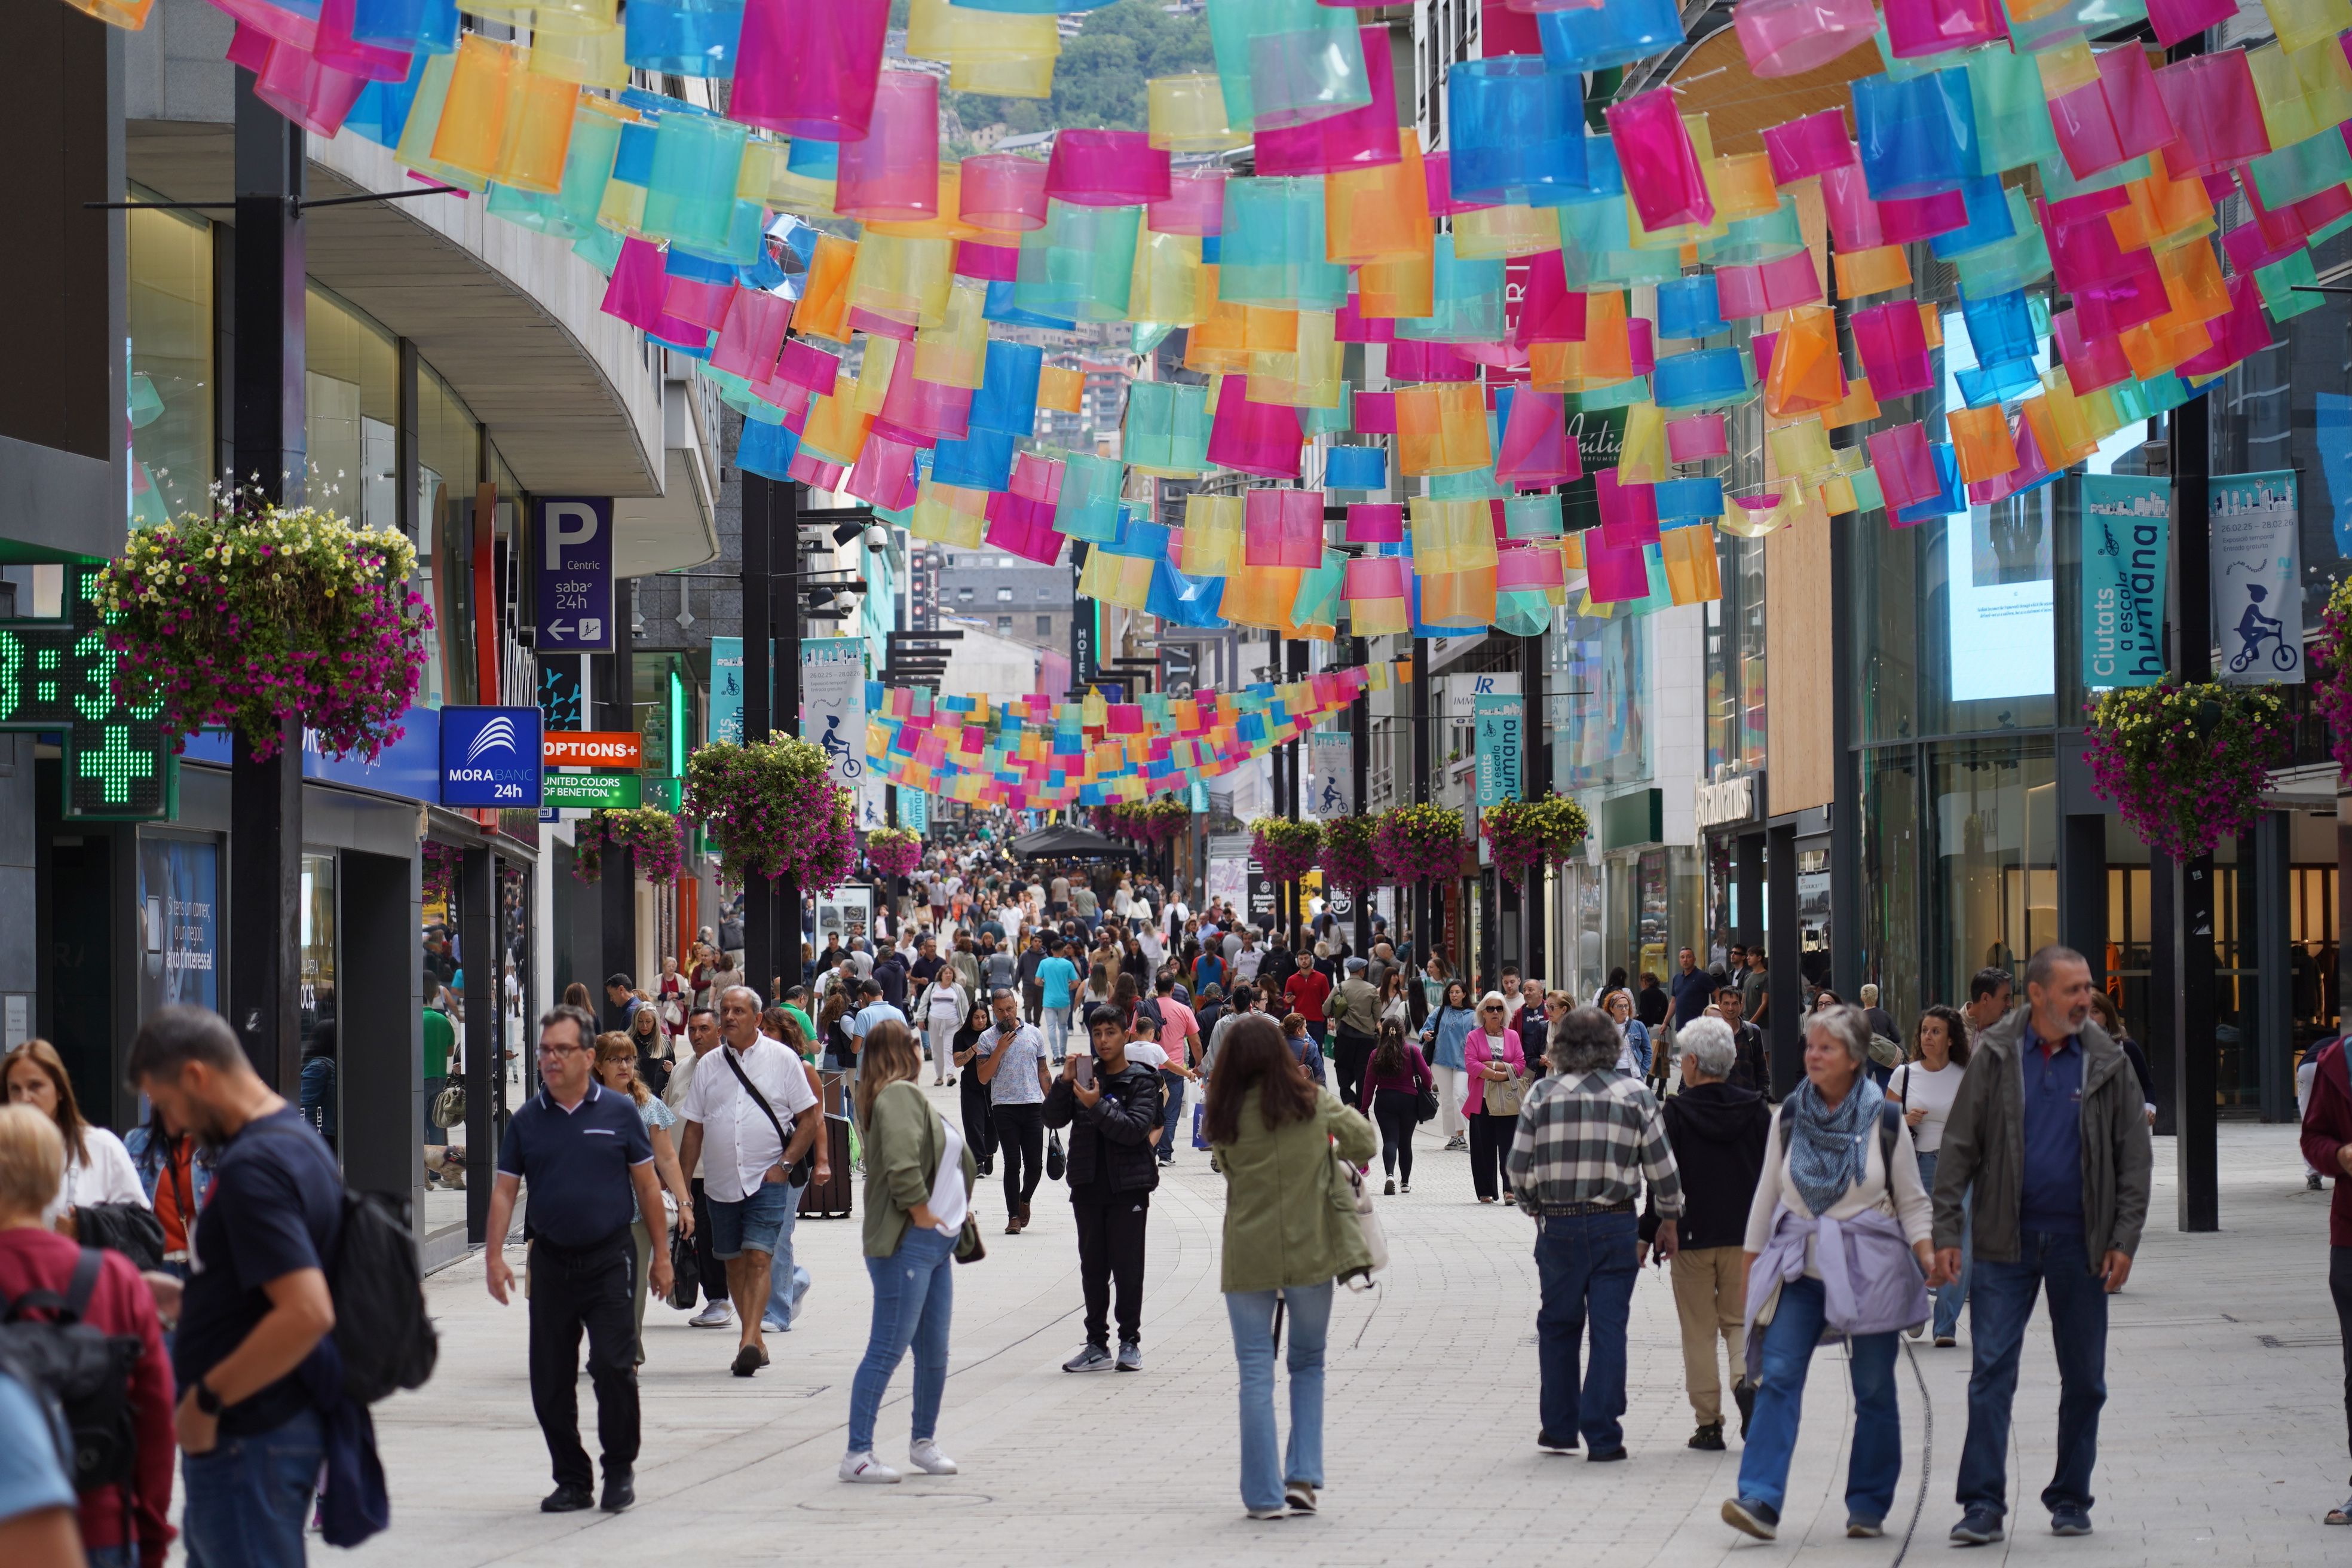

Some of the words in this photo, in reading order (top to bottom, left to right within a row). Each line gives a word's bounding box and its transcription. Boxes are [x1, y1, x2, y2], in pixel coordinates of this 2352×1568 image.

[545, 502, 598, 570] P
[2222, 523, 2253, 532] 26.02.25
[2262, 519, 2293, 529] 28.02.26
[568, 561, 600, 570] Cèntric
[556, 594, 587, 609] 24h
[2115, 571, 2133, 633] escala
[2129, 525, 2162, 675] humana
[2093, 588, 2115, 676] Ciutats
[2121, 640, 2133, 651] a
[544, 742, 638, 757] OPTIONS+
[1499, 719, 1517, 801] humana
[1492, 745, 1501, 778] escala
[544, 777, 578, 786] UNITED
[580, 777, 620, 788] COLORS
[1481, 754, 1493, 801] Ciutats
[494, 784, 522, 798] 24h
[557, 787, 610, 797] BENETTON.
[168, 896, 173, 915] Si
[173, 899, 185, 916] tens
[185, 901, 191, 916] un
[192, 902, 210, 923] comerç
[174, 925, 179, 940] o
[179, 926, 186, 940] un
[187, 924, 204, 947] negoci,
[167, 947, 179, 969] això
[180, 947, 212, 970] t'interessa!
